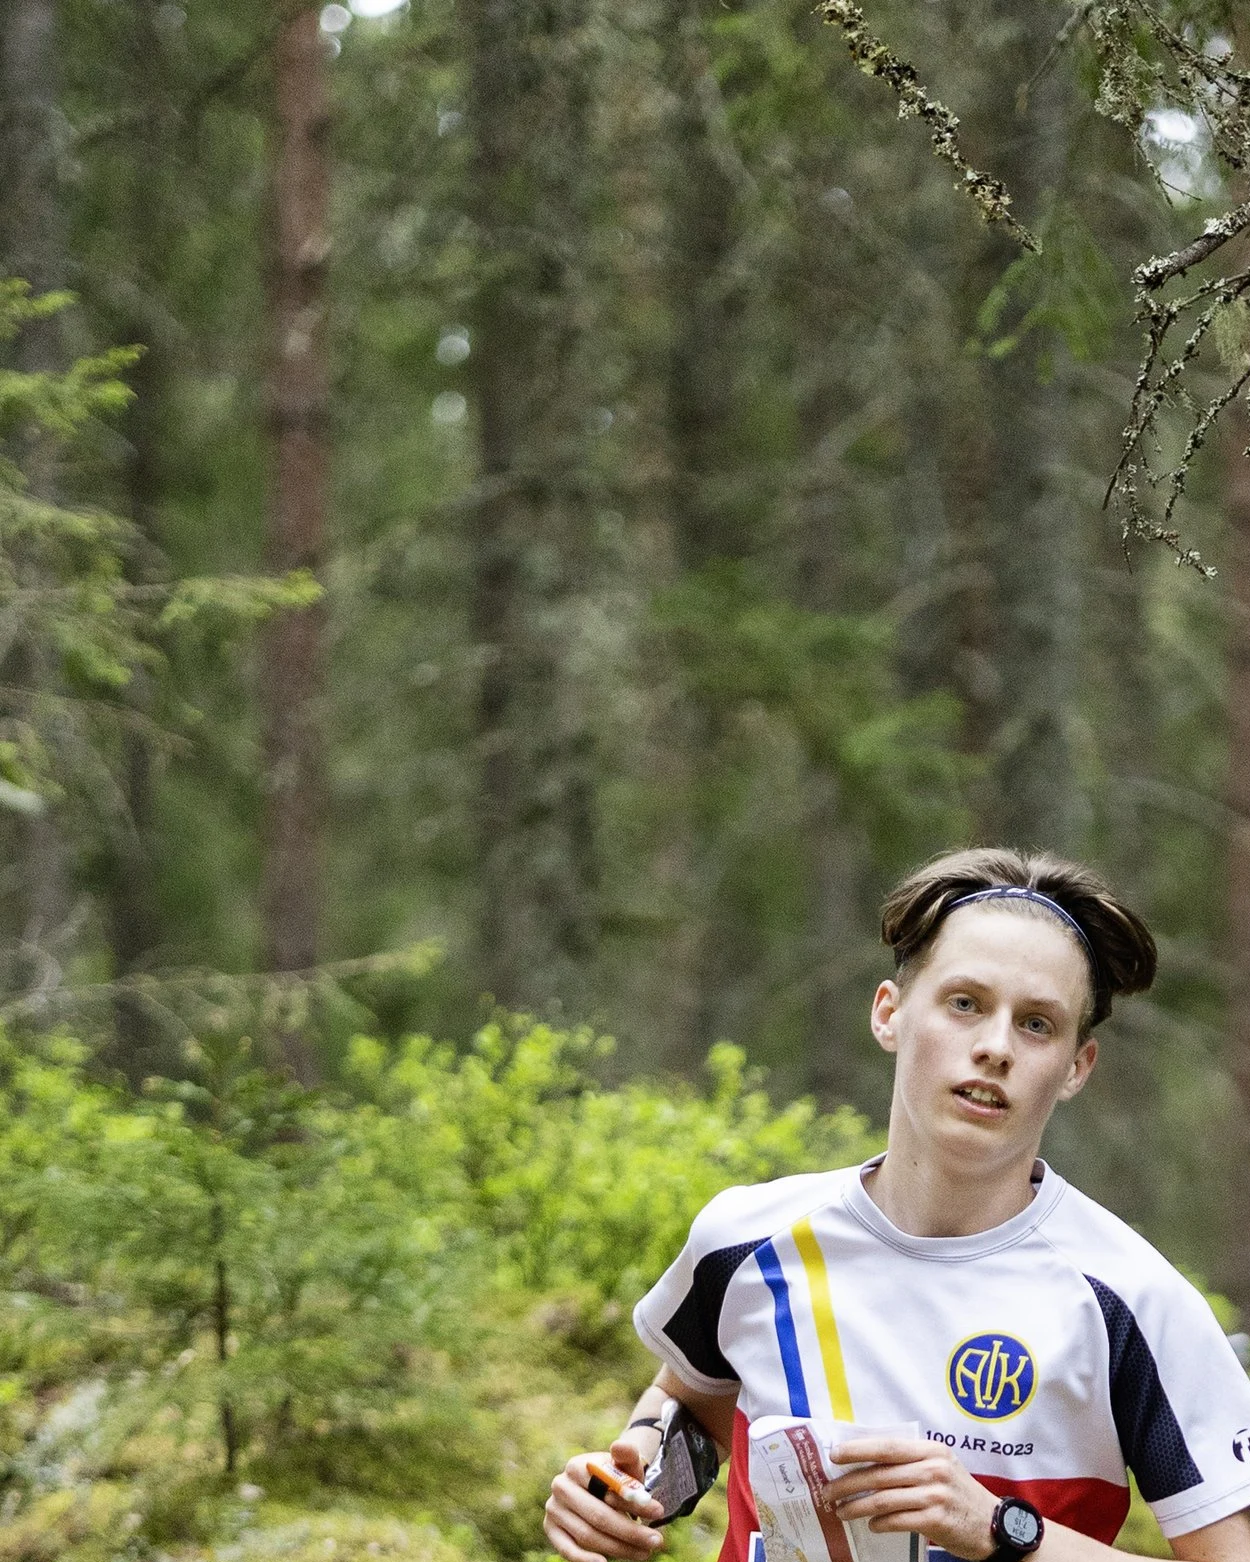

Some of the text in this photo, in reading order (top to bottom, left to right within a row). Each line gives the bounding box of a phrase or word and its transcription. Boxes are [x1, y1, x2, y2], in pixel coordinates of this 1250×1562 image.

[926, 1430, 1034, 1456] 100 ÅR 2023
